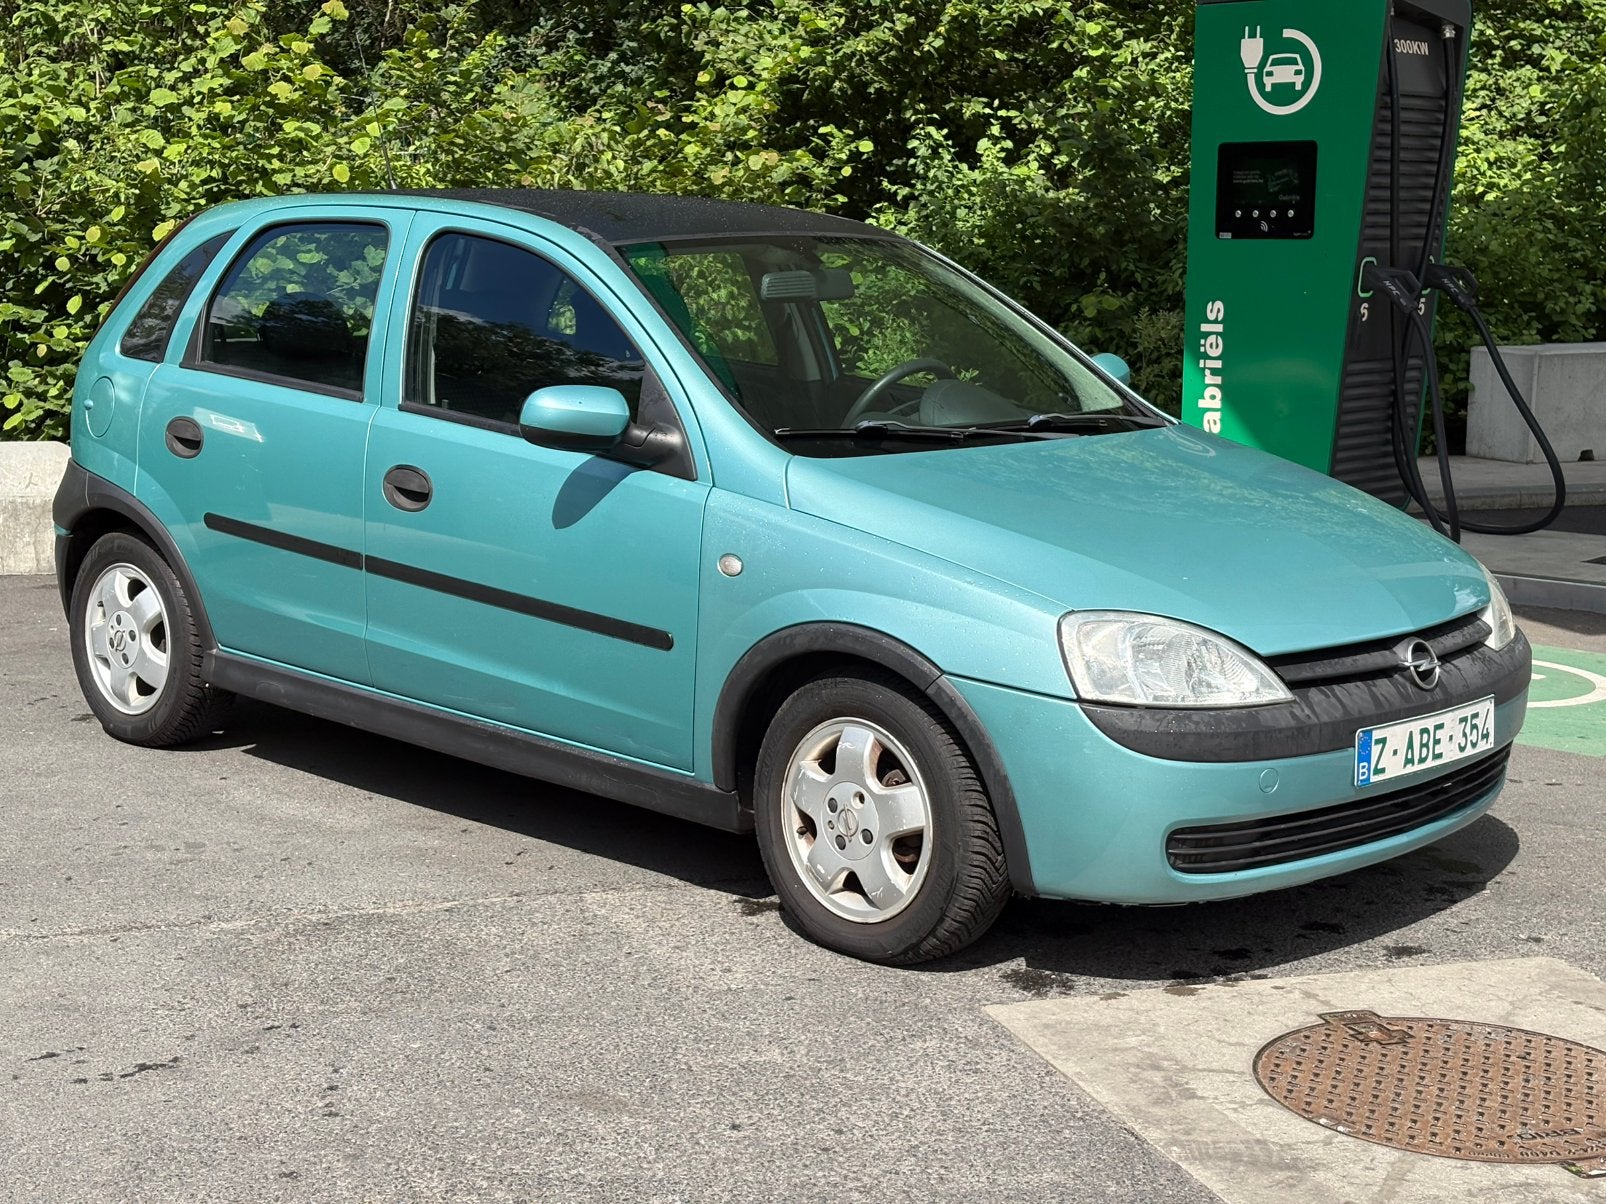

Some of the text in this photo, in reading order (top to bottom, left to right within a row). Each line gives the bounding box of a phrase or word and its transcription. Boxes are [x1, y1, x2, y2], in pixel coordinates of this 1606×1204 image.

[1393, 38, 1429, 56] 300KW
[1360, 302, 1369, 321] 6
[1418, 297, 1425, 315] 5
[1197, 300, 1225, 434] abriëls
[1359, 708, 1490, 780] B Z-ABE-354
